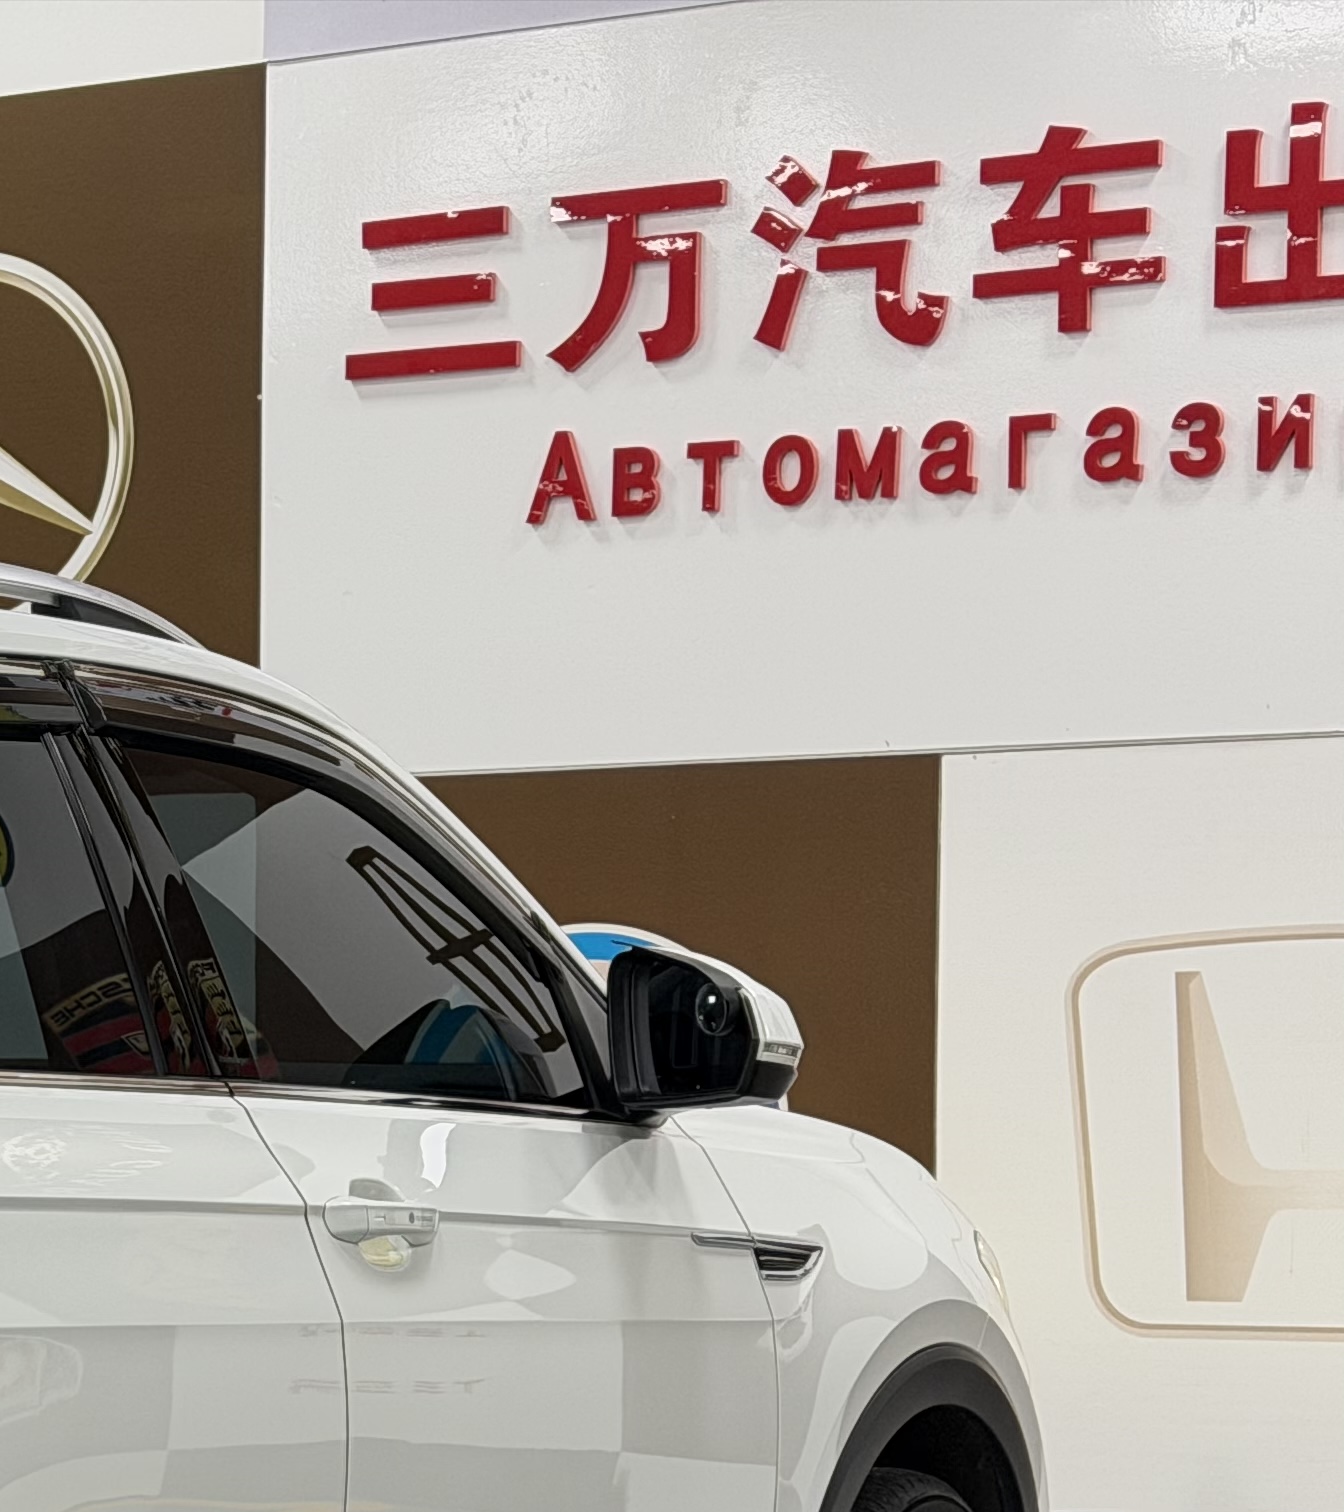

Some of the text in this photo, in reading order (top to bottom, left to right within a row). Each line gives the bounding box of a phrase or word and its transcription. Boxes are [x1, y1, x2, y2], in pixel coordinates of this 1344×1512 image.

[345, 101, 1344, 382] 三万汽车出
[525, 393, 1316, 525] Автомагази
